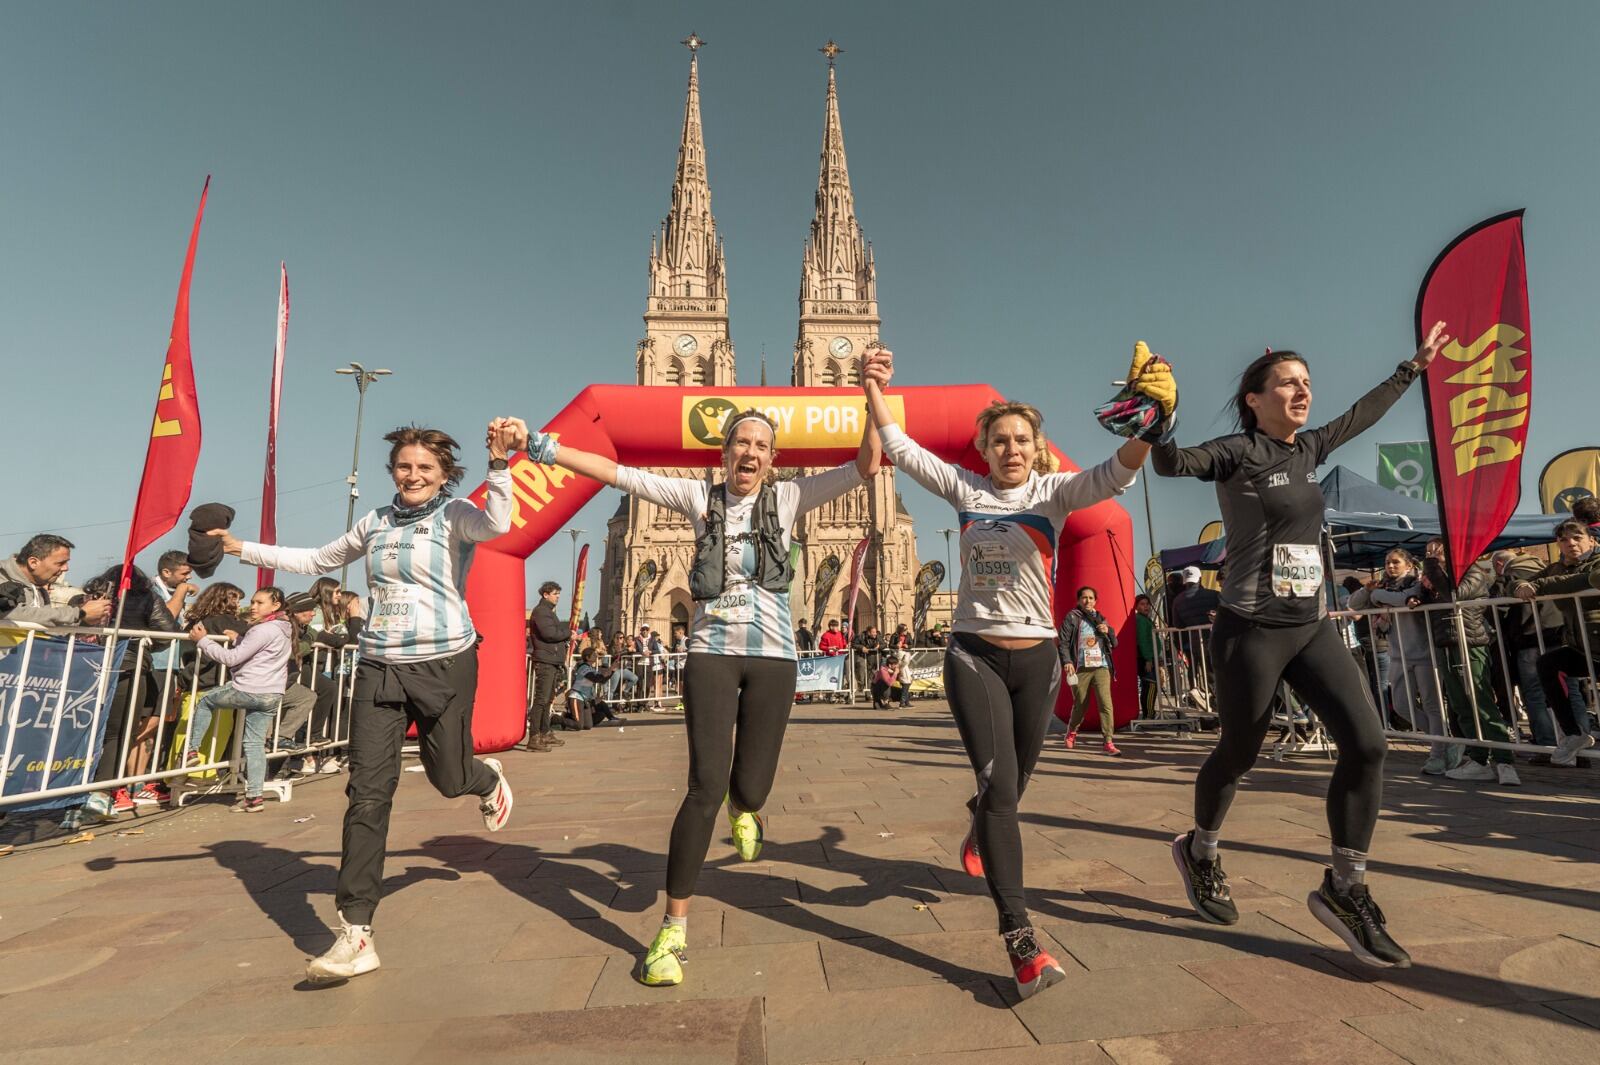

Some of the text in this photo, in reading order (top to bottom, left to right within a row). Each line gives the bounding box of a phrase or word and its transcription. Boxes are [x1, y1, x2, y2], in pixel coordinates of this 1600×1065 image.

[1441, 323, 1528, 477] PIPAS
[806, 405, 859, 434] POR
[413, 527, 429, 535] ARG
[1275, 547, 1292, 567] 10k
[975, 561, 1011, 575] 0599
[1281, 566, 1315, 580] 0219
[714, 594, 747, 608] 2526
[379, 602, 409, 616] 2033
